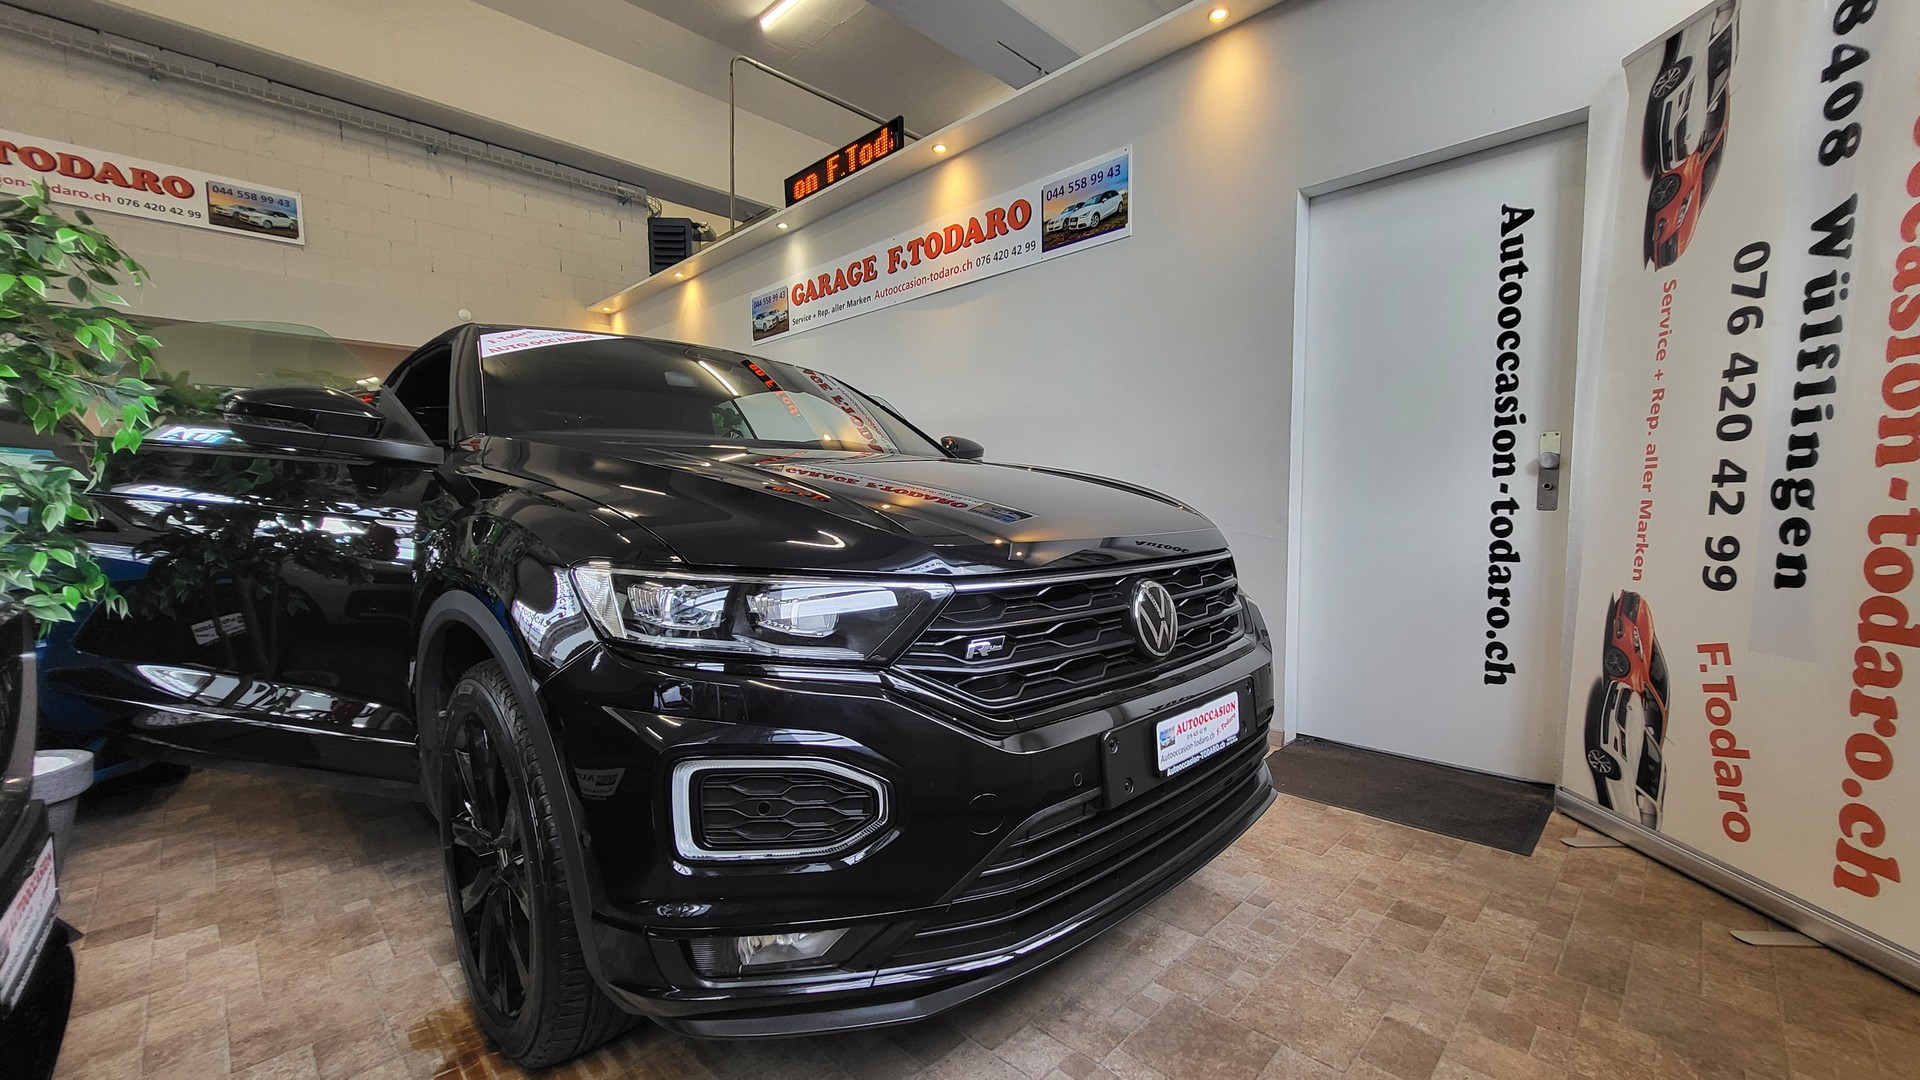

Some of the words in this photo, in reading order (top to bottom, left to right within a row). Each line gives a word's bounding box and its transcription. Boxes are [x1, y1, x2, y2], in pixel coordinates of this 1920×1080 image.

[1818, 0, 1878, 167] 8408
[117, 197, 140, 208] 076
[143, 202, 166, 213] 420
[169, 207, 185, 216] 42
[188, 210, 202, 219] 99
[212, 185, 234, 197] 044
[237, 190, 258, 202] 558
[260, 193, 274, 204] 99
[277, 196, 290, 208] 43
[793, 172, 818, 200] on
[1046, 185, 1065, 201] 044
[1068, 177, 1087, 194] 558
[1090, 171, 1104, 186] 99
[1106, 164, 1121, 178] 43
[791, 255, 878, 307] GARAGE
[887, 199, 1032, 274] F.TODARO
[792, 314, 812, 326] Service
[817, 309, 831, 318] Rep.
[831, 303, 846, 313] aller
[846, 295, 872, 309] Marken
[874, 258, 973, 300] Autooccasion-todaro.ch
[975, 254, 991, 268] 076
[993, 249, 1009, 262] 420
[1011, 244, 1022, 257] 42
[1025, 240, 1036, 253] 99
[1727, 241, 1771, 335] 076
[488, 342, 528, 354] AUTO
[1655, 278, 1678, 362] Service
[1654, 368, 1664, 381] +
[1716, 352, 1759, 443] 420
[1770, 192, 1858, 590] Wülflingen
[1483, 203, 1535, 687] Autooccasion-todaro.ch
[1646, 387, 1665, 436] Rep.
[1642, 443, 1659, 493] aller
[1708, 458, 1748, 516] 42
[1632, 500, 1653, 582] Marken
[1833, 115, 1920, 898] asion-todaro.ch
[1702, 535, 1741, 592] 99
[1176, 701, 1236, 736] AUTOOCCASION
[1696, 641, 1752, 844] F.Todaro
